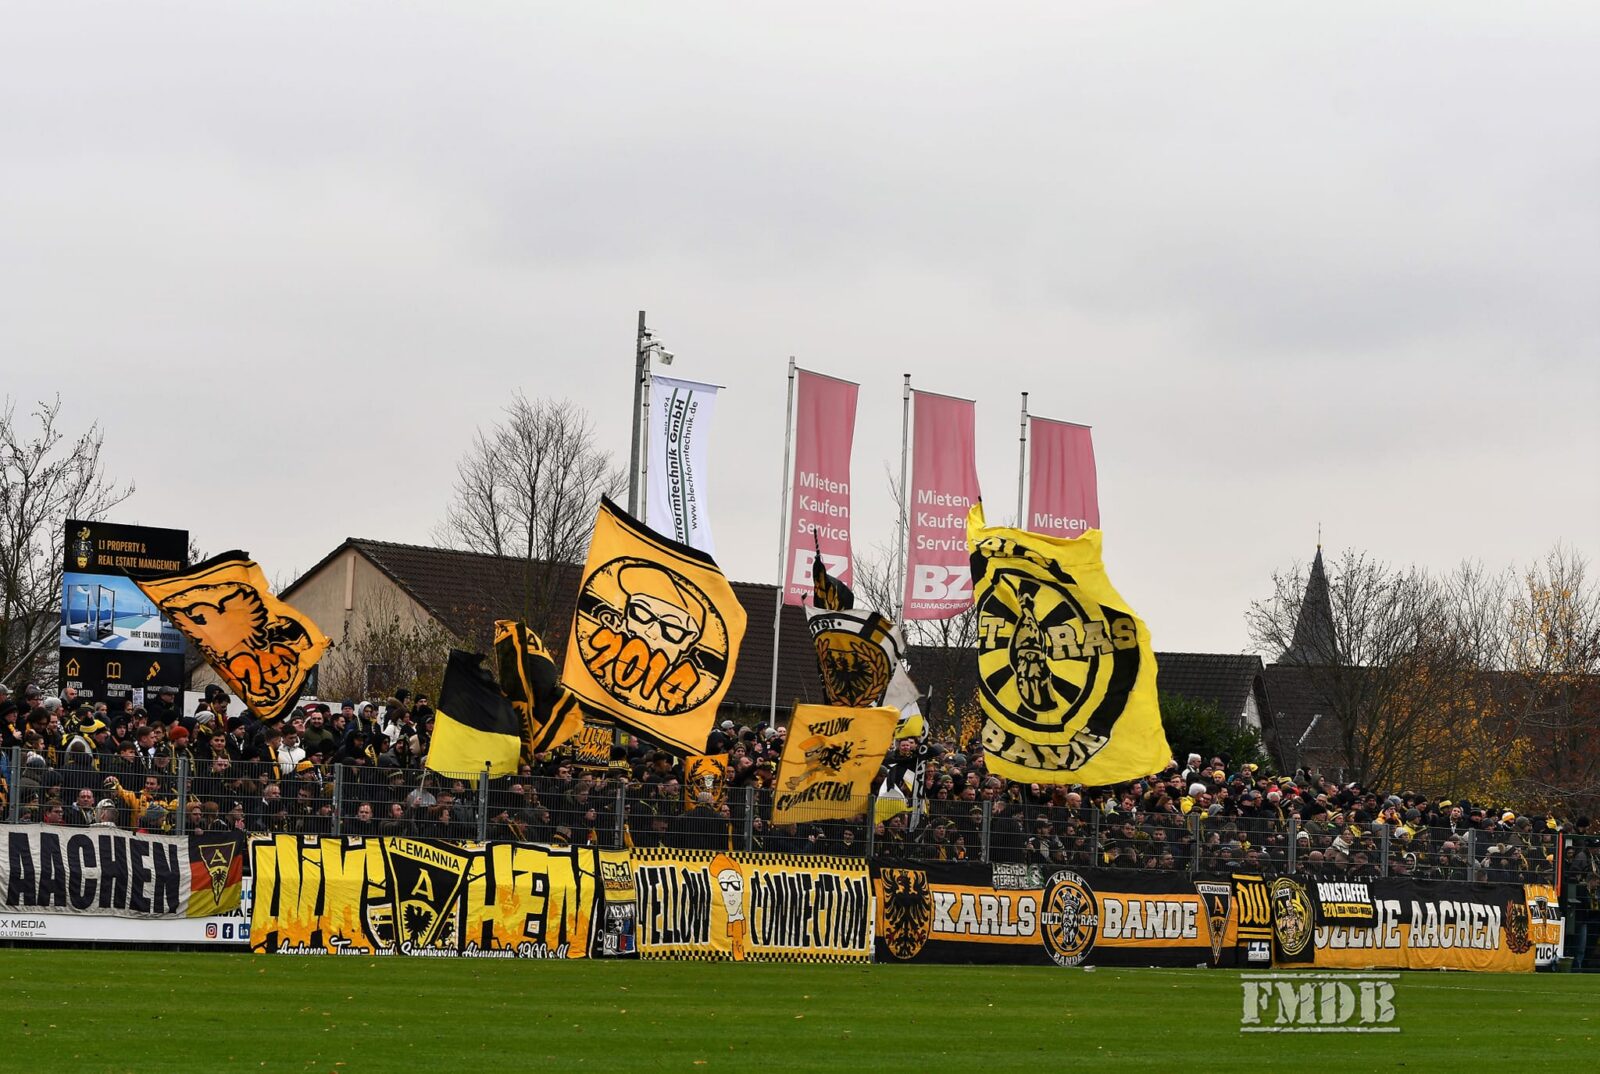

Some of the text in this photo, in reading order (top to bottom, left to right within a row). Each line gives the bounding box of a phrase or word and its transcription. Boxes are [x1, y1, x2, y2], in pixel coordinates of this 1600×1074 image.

[670, 398, 685, 443] GmbH
[684, 401, 698, 530] www.blechformtechnik.de
[97, 554, 181, 572] REAL ESTATE MANAGEMENT
[106, 540, 140, 553] PROPERTY
[141, 542, 146, 554] &
[911, 565, 974, 600] BZ
[150, 640, 160, 648] DER
[808, 717, 855, 737] YELLOW
[389, 837, 461, 871] ALEMANNIA
[5, 831, 181, 915] AACHEN
[411, 867, 435, 902] A
[1052, 871, 1083, 887] KARLS
[634, 866, 712, 945] YELLOW
[1213, 895, 1225, 915] A
[1316, 882, 1371, 903] BOXSTAFFEL
[11, 919, 47, 929] MEDIA
[750, 870, 870, 950] CONNECTION
[931, 891, 1036, 937] KARLS
[1102, 897, 1199, 939] BANDE
[1407, 900, 1502, 950] AACHEN
[1053, 952, 1085, 966] BANDE
